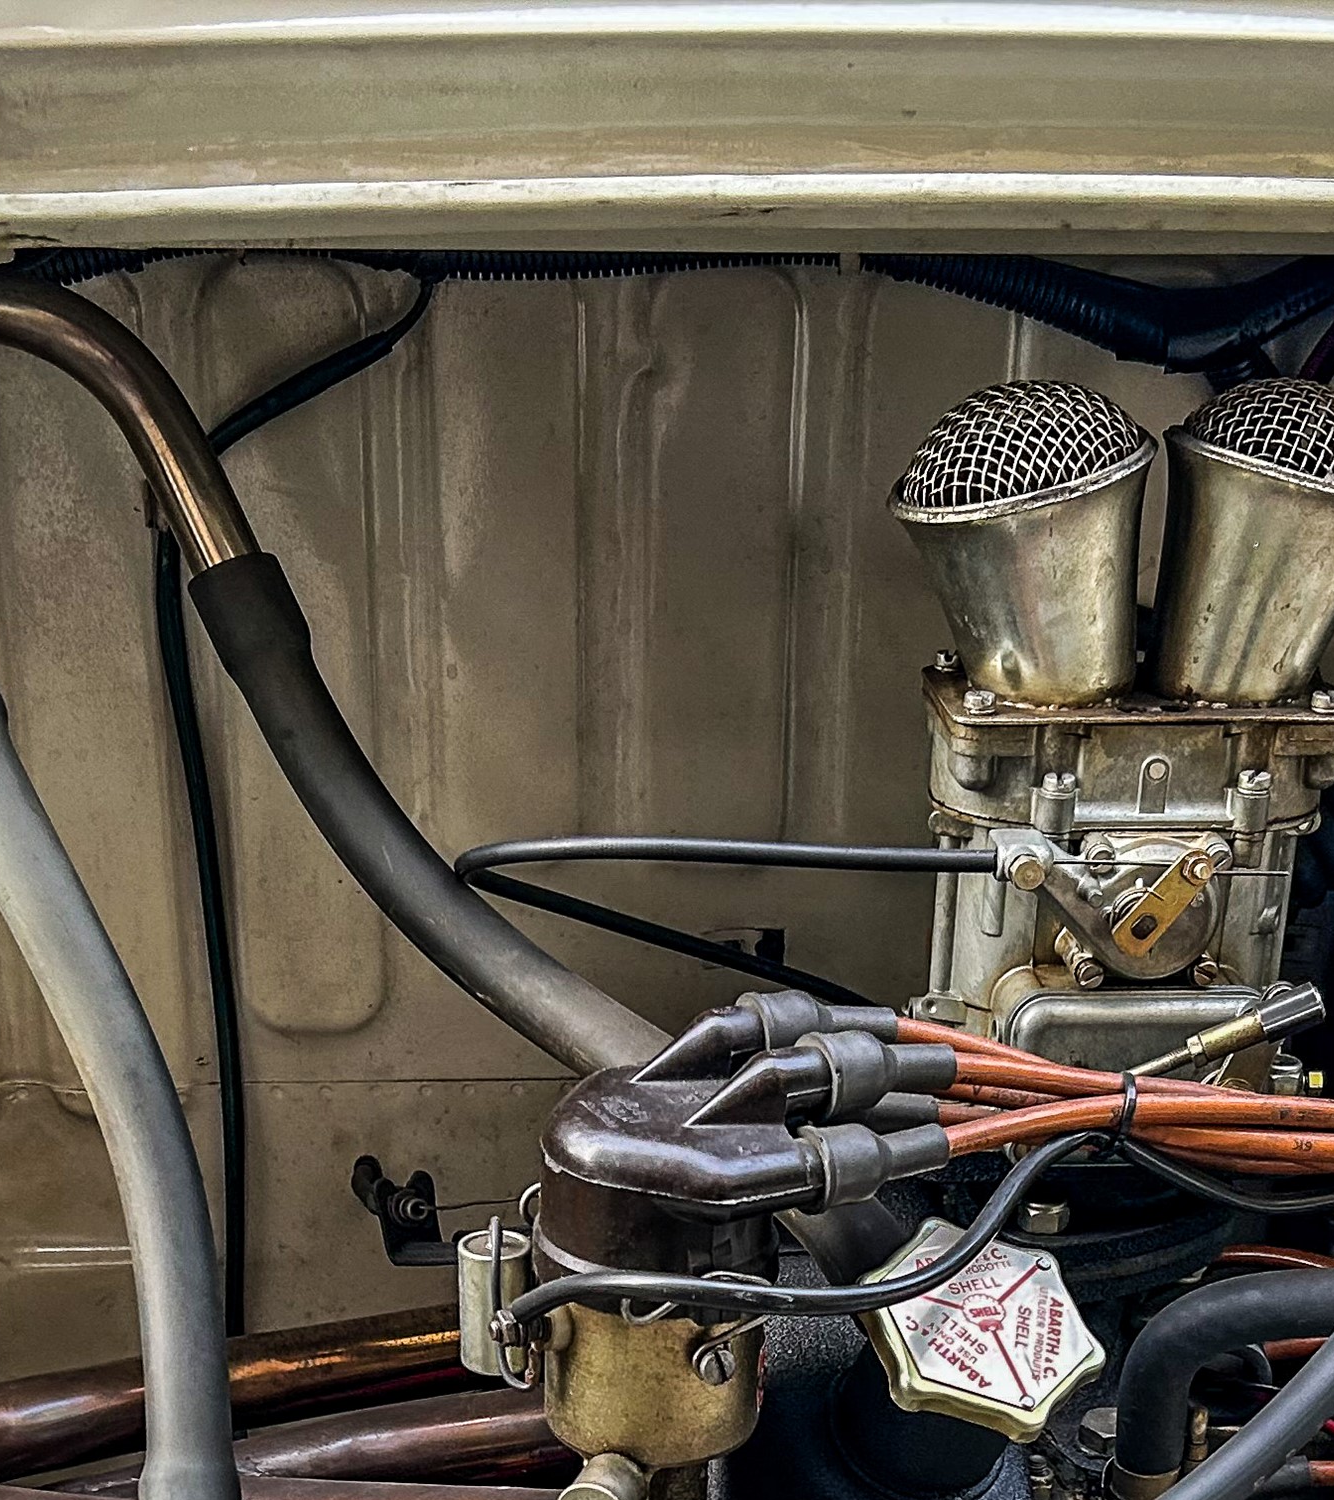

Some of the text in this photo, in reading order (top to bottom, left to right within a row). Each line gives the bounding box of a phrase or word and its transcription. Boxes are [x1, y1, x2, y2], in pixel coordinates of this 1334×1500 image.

[948, 1275, 1003, 1295] SHELL
[905, 1315, 920, 1332] C.
[941, 1311, 988, 1355] SHELL
[969, 1305, 1001, 1318] SHELL
[1014, 1305, 1032, 1348] SHELL
[1047, 1297, 1064, 1358] ABARTH
[926, 1322, 977, 1365] USE ONLY
[927, 1338, 992, 1389] ABARTH
[1031, 1333, 1046, 1381] PRODUITS
[1042, 1367, 1058, 1380] C.
